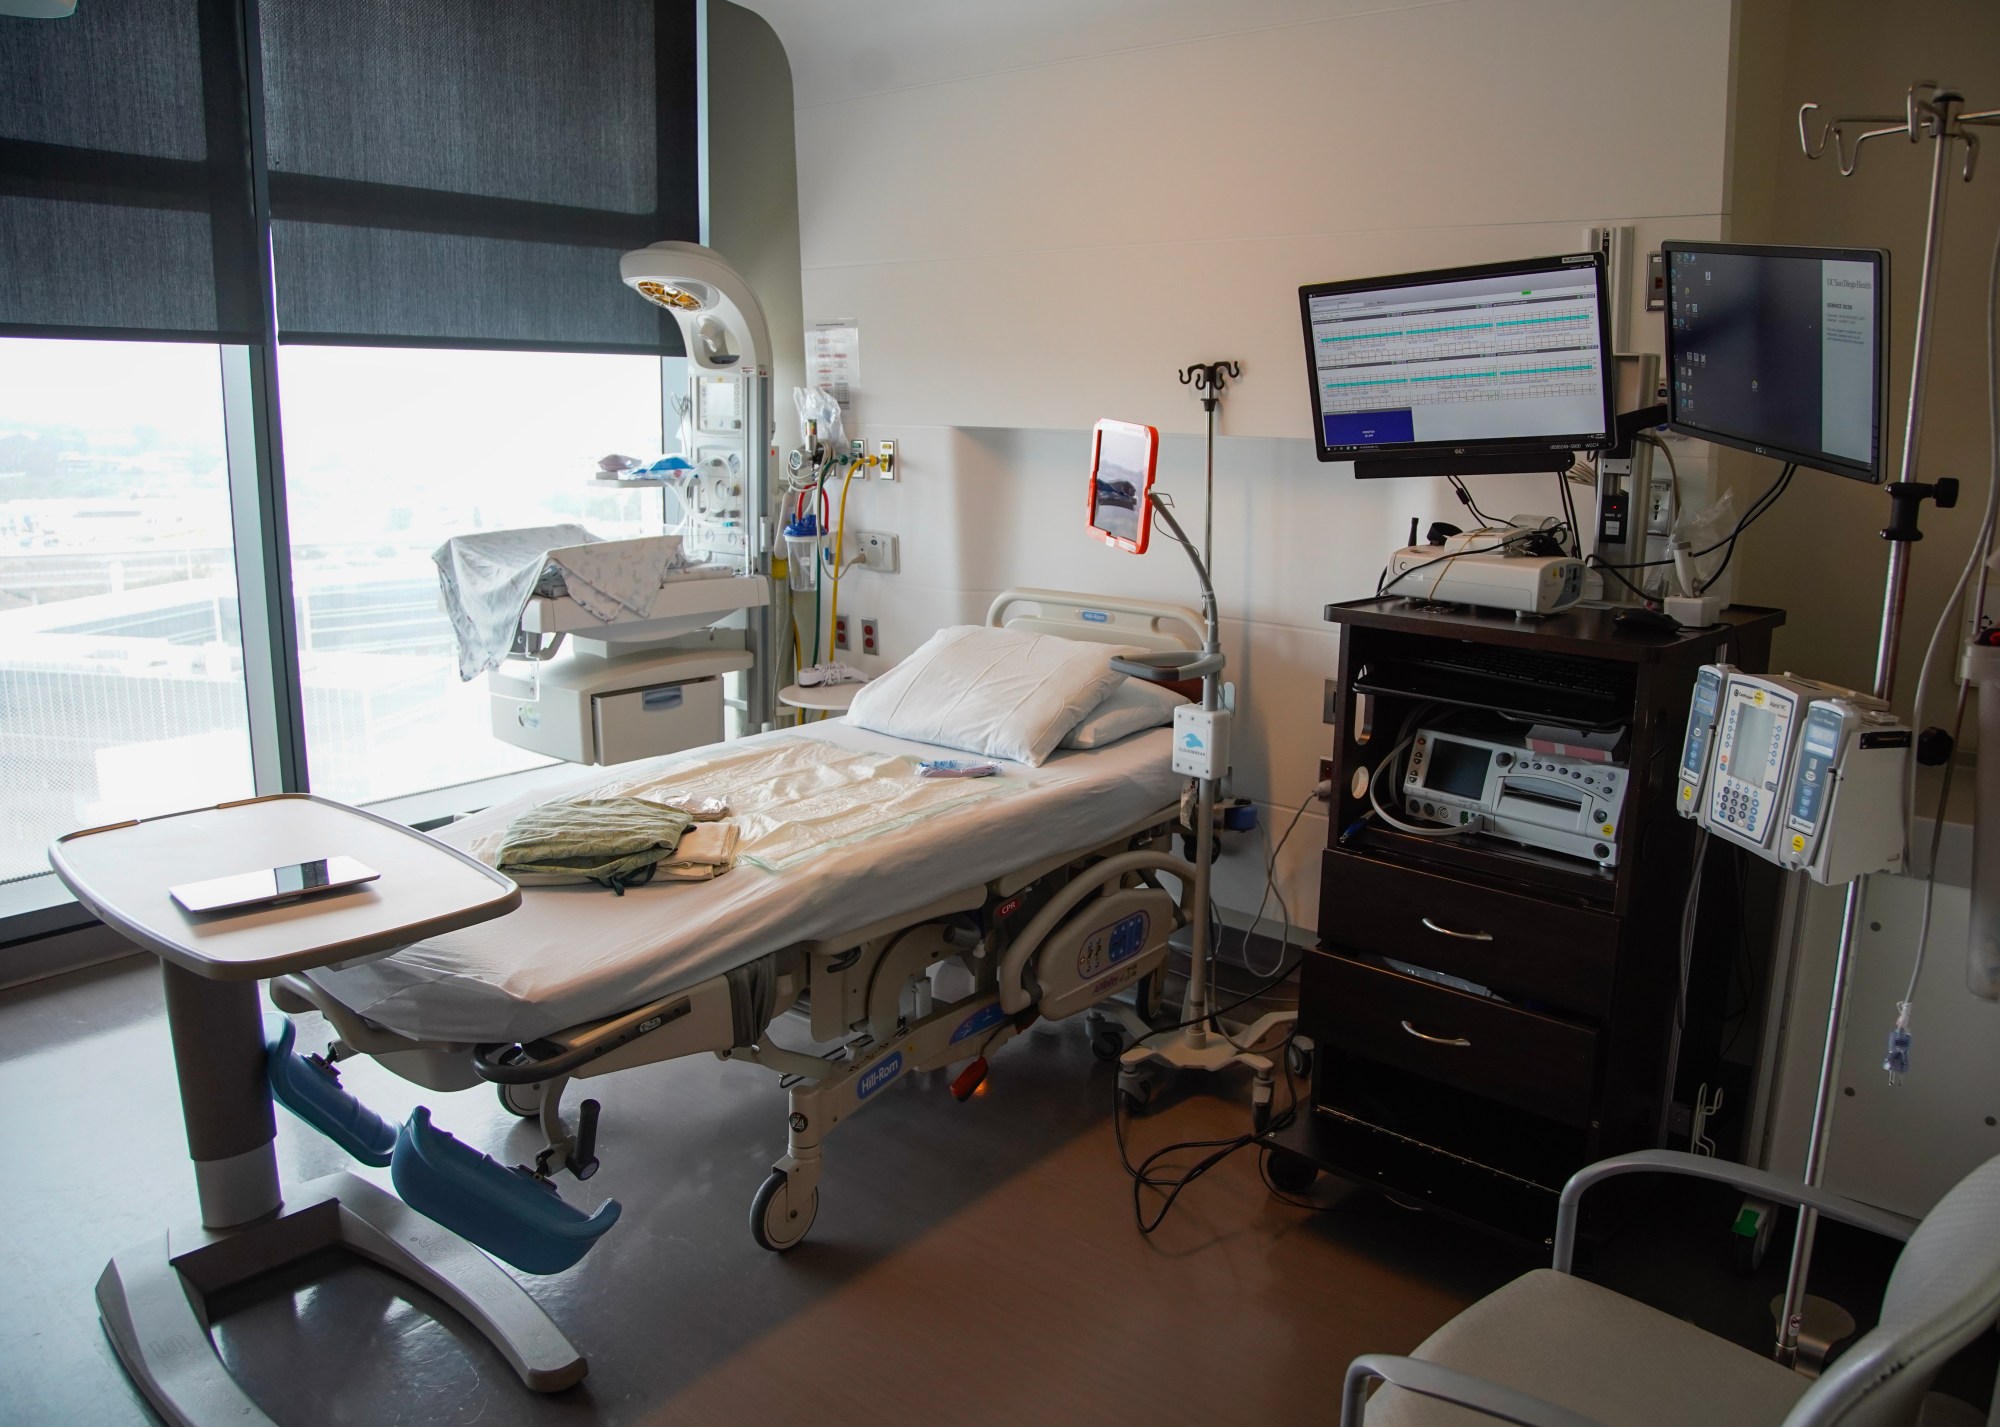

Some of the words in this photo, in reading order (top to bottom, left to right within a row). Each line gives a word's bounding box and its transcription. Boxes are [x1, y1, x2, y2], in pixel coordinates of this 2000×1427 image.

[1843, 279, 1856, 289] Diego
[1856, 280, 1872, 289] Health
[1001, 901, 1016, 914] CPR
[861, 1059, 898, 1093] Hill-Rom
